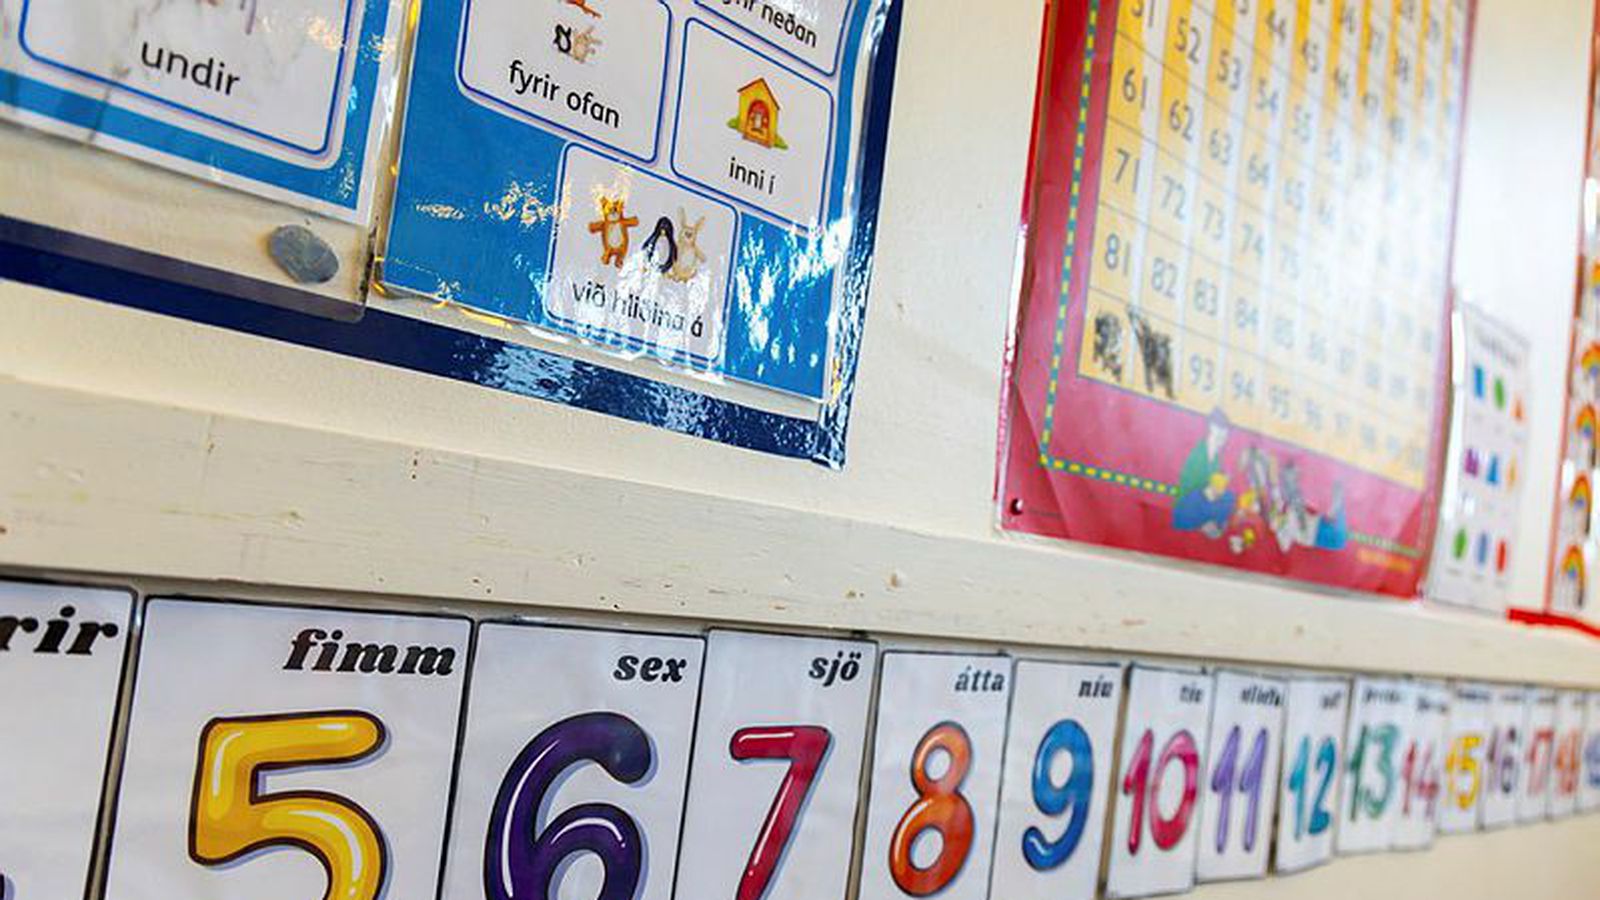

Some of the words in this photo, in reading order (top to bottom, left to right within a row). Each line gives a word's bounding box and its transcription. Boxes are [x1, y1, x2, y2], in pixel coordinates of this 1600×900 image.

[761, 4, 817, 48] neðan
[1175, 17, 1200, 64] 52
[1217, 49, 1242, 91] 53
[140, 41, 241, 96] undir
[508, 60, 560, 102] fyrir
[567, 90, 620, 128] ofan
[1122, 67, 1147, 110] 61
[1169, 99, 1193, 142] 62
[1209, 128, 1233, 167] 63
[1248, 154, 1271, 189] 64
[729, 157, 765, 190] inni
[768, 175, 776, 195] í
[1116, 148, 1140, 193] 71
[1161, 175, 1186, 220] 72
[1202, 200, 1225, 241] 73
[572, 281, 606, 308] við
[691, 316, 704, 338] á
[1104, 233, 1131, 277] 81
[1152, 257, 1179, 299] 82
[1193, 278, 1218, 317] 83
[1190, 353, 1214, 391] 93
[0, 606, 119, 656] rir
[283, 629, 456, 675] fimm
[613, 654, 687, 683] sex
[808, 651, 862, 687] sjö
[954, 665, 1006, 693] átta
[1021, 718, 1094, 872] 9
[1123, 728, 1199, 857] 10
[1211, 724, 1268, 855] 11
[1288, 735, 1337, 842] 12
[1348, 722, 1400, 824] 13
[1401, 737, 1440, 822] 14
[1444, 731, 1483, 812] 15
[1486, 725, 1519, 795] 16
[188, 709, 388, 900] 5
[484, 711, 652, 900] 6
[728, 724, 836, 900] 7
[889, 720, 975, 897] 8
